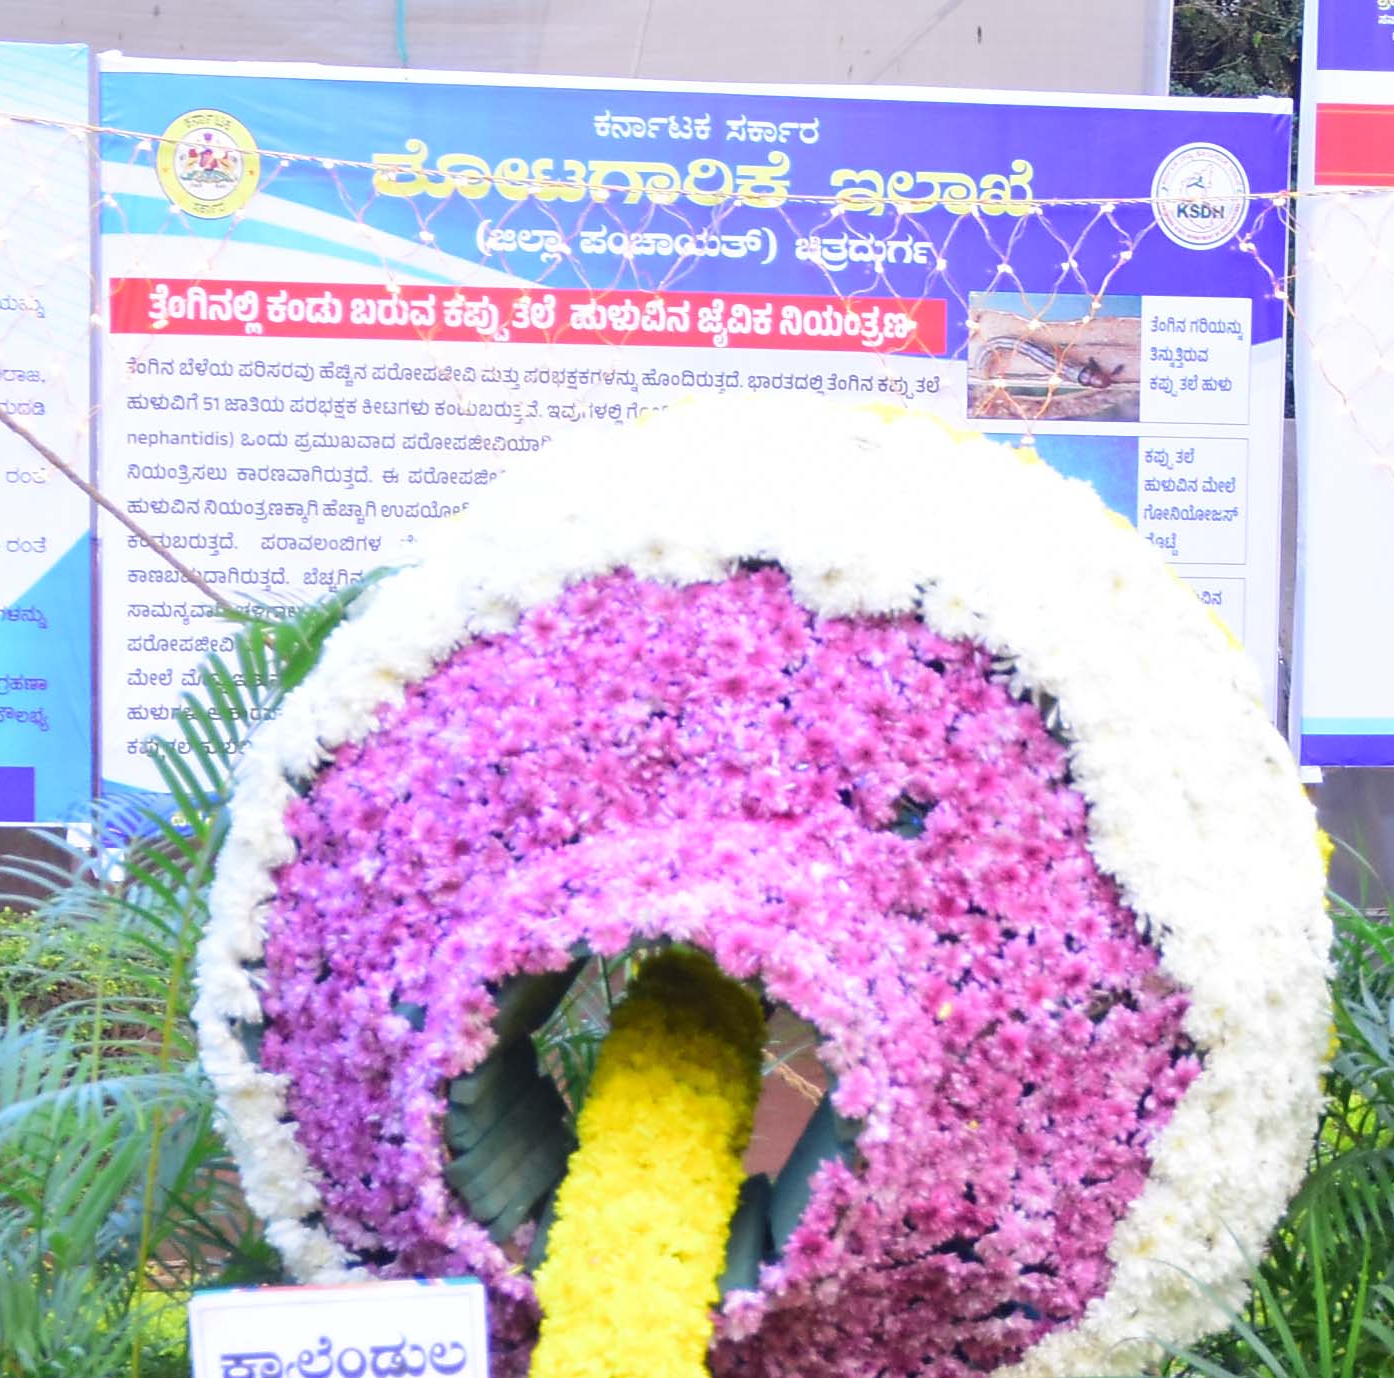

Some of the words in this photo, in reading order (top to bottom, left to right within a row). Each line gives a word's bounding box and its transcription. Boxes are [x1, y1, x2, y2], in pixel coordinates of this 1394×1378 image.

[593, 110, 711, 141] ಕರ್ನಾಟಕ
[726, 114, 819, 145] ಸರ್ಕಾರ
[266, 290, 343, 326] ಕಂಡು
[350, 291, 443, 327] ಬರುವ
[443, 295, 510, 342] ಕಪ್ಪು
